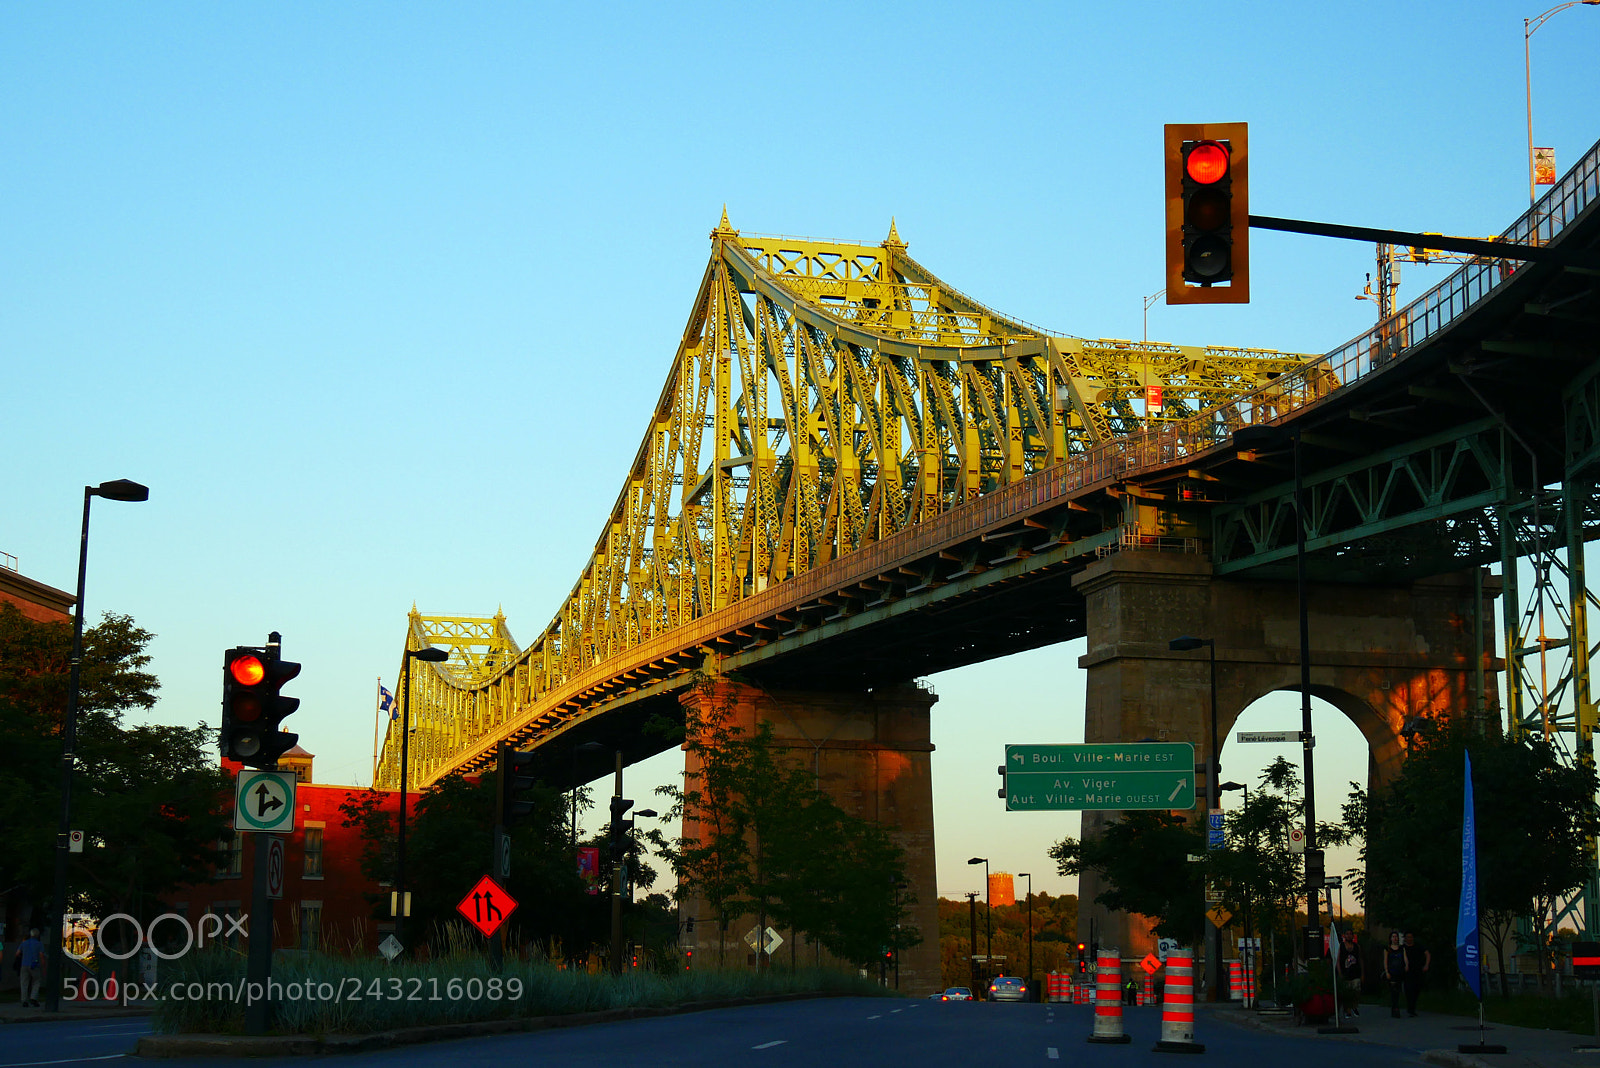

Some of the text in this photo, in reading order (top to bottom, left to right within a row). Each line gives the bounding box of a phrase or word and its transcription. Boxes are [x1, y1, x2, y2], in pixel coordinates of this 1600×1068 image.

[1032, 752, 1174, 763] Boul. Ville-Marie EST
[1053, 778, 1117, 791] Av. Viger
[1011, 793, 1160, 804] Aut. Ville-Marie OUEST
